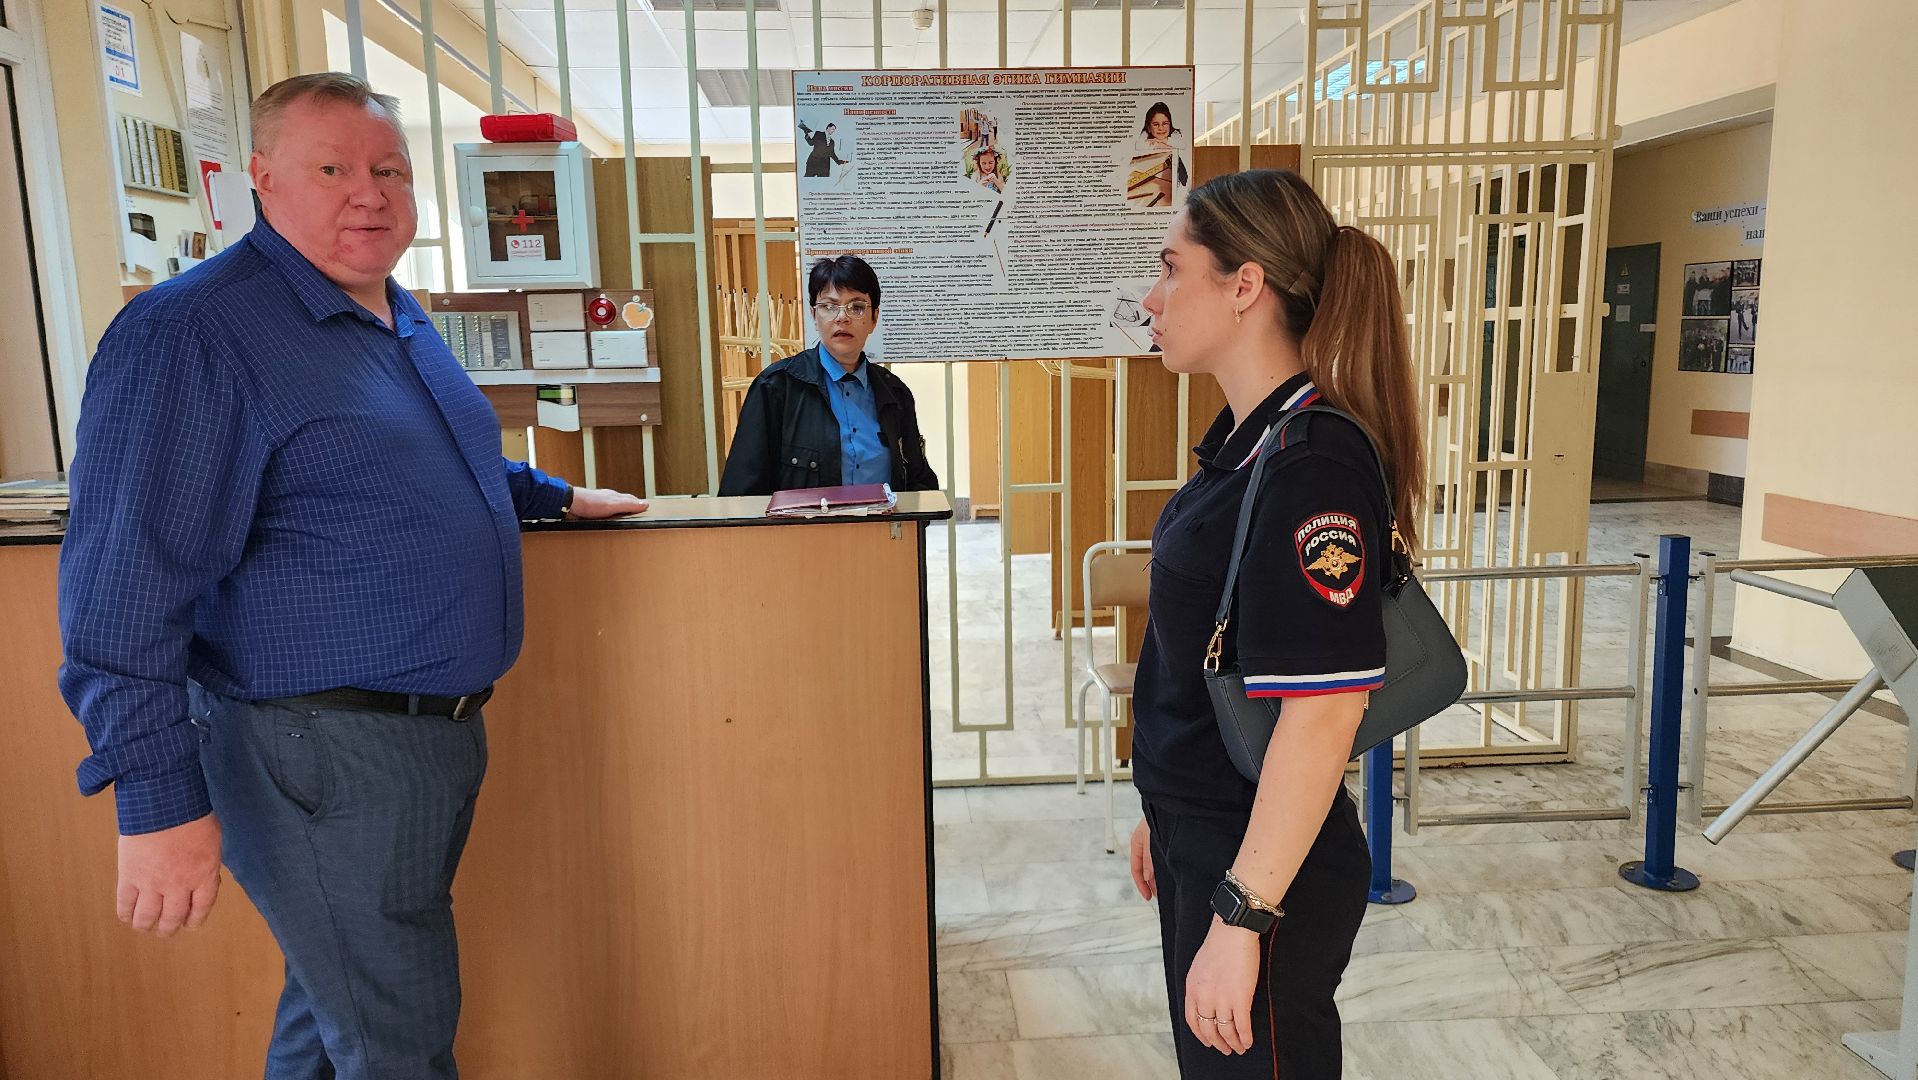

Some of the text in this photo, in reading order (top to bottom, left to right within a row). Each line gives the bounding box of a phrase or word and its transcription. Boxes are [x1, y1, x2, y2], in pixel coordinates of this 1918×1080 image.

[861, 72, 1126, 87] КОРПОРАТИВНАЯ ЭТИКА ГИМНАЗИИ
[1696, 210, 1722, 223] Ваши
[1724, 205, 1759, 223] успехи
[522, 239, 542, 249] 112
[1297, 515, 1357, 543] ПОЛИЦИЯ
[1304, 530, 1357, 557] РОССИЯ
[1328, 587, 1355, 605] МВД
